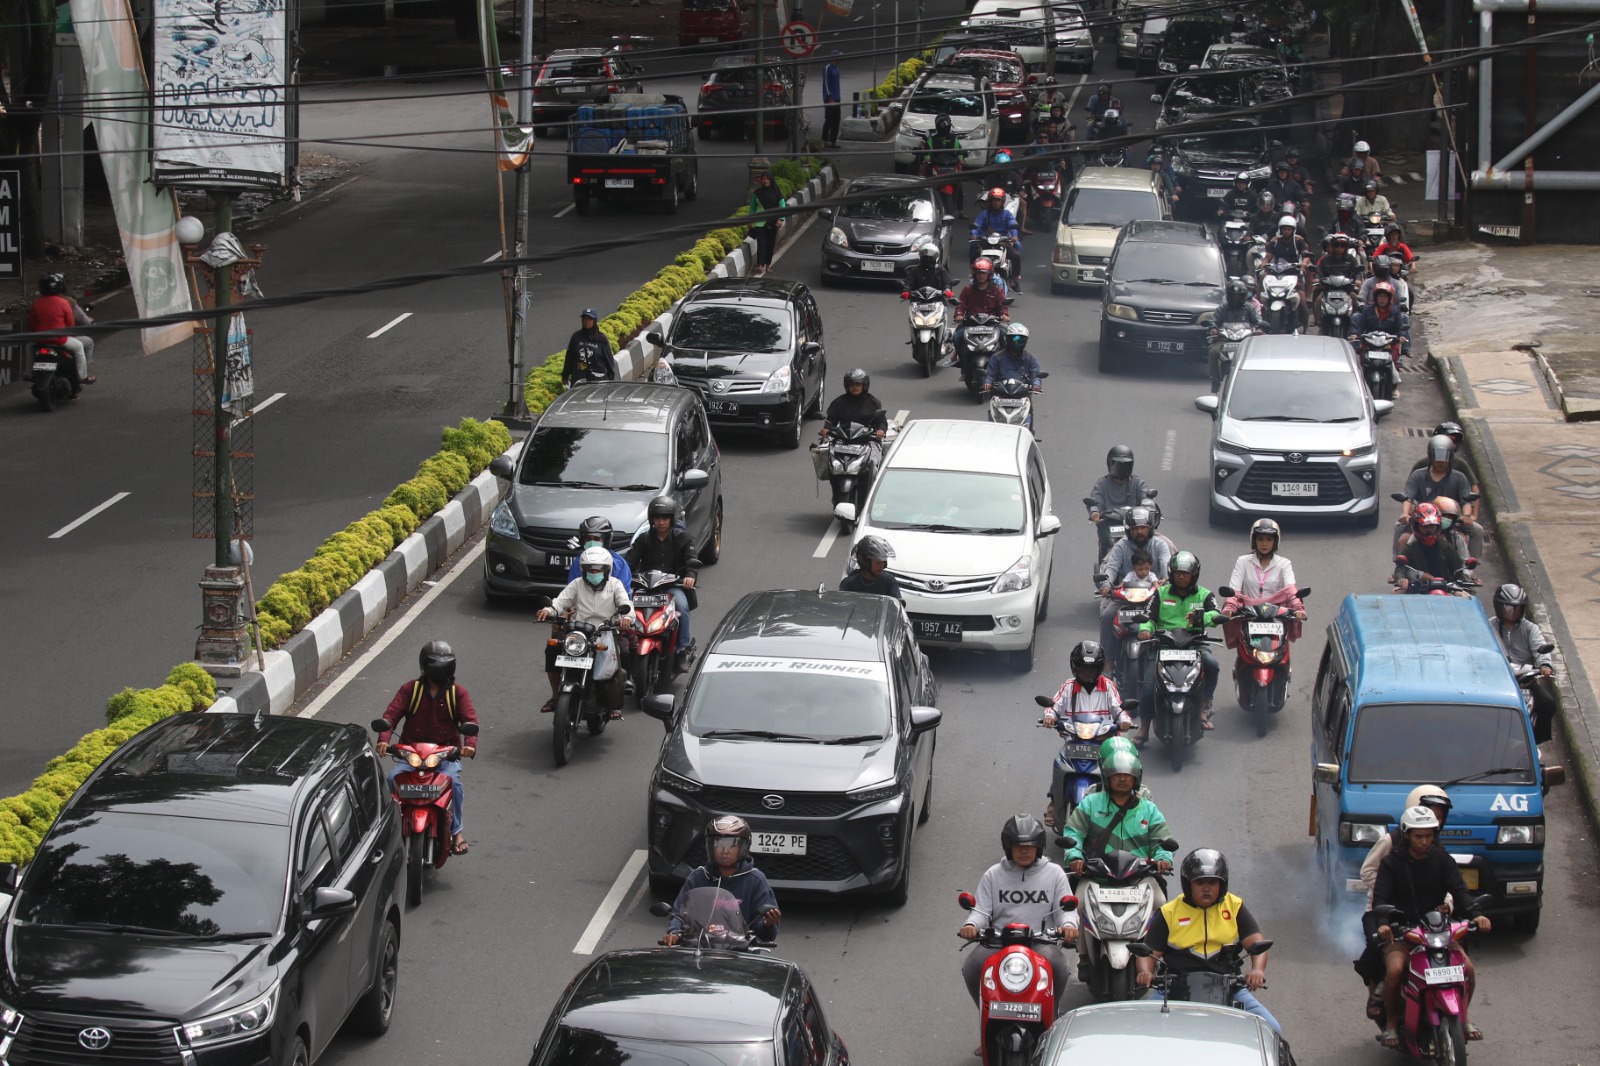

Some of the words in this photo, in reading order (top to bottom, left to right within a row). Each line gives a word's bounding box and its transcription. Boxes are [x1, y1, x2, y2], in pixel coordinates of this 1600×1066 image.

[1273, 484, 1279, 492] N
[1282, 484, 1300, 492] 1149
[1303, 484, 1317, 492] ABT
[550, 555, 560, 566] AG
[920, 621, 940, 632] 1957
[944, 623, 961, 634] AAZ
[717, 661, 783, 669] NIGHT
[788, 661, 873, 675] RUNNER
[1490, 793, 1528, 812] AG
[758, 834, 785, 847] 1242
[791, 835, 805, 848] PE
[998, 890, 1050, 904] KOXA
[1432, 968, 1452, 977] 6890
[1003, 1004, 1023, 1012] 3220
[1029, 1005, 1039, 1013] LK
